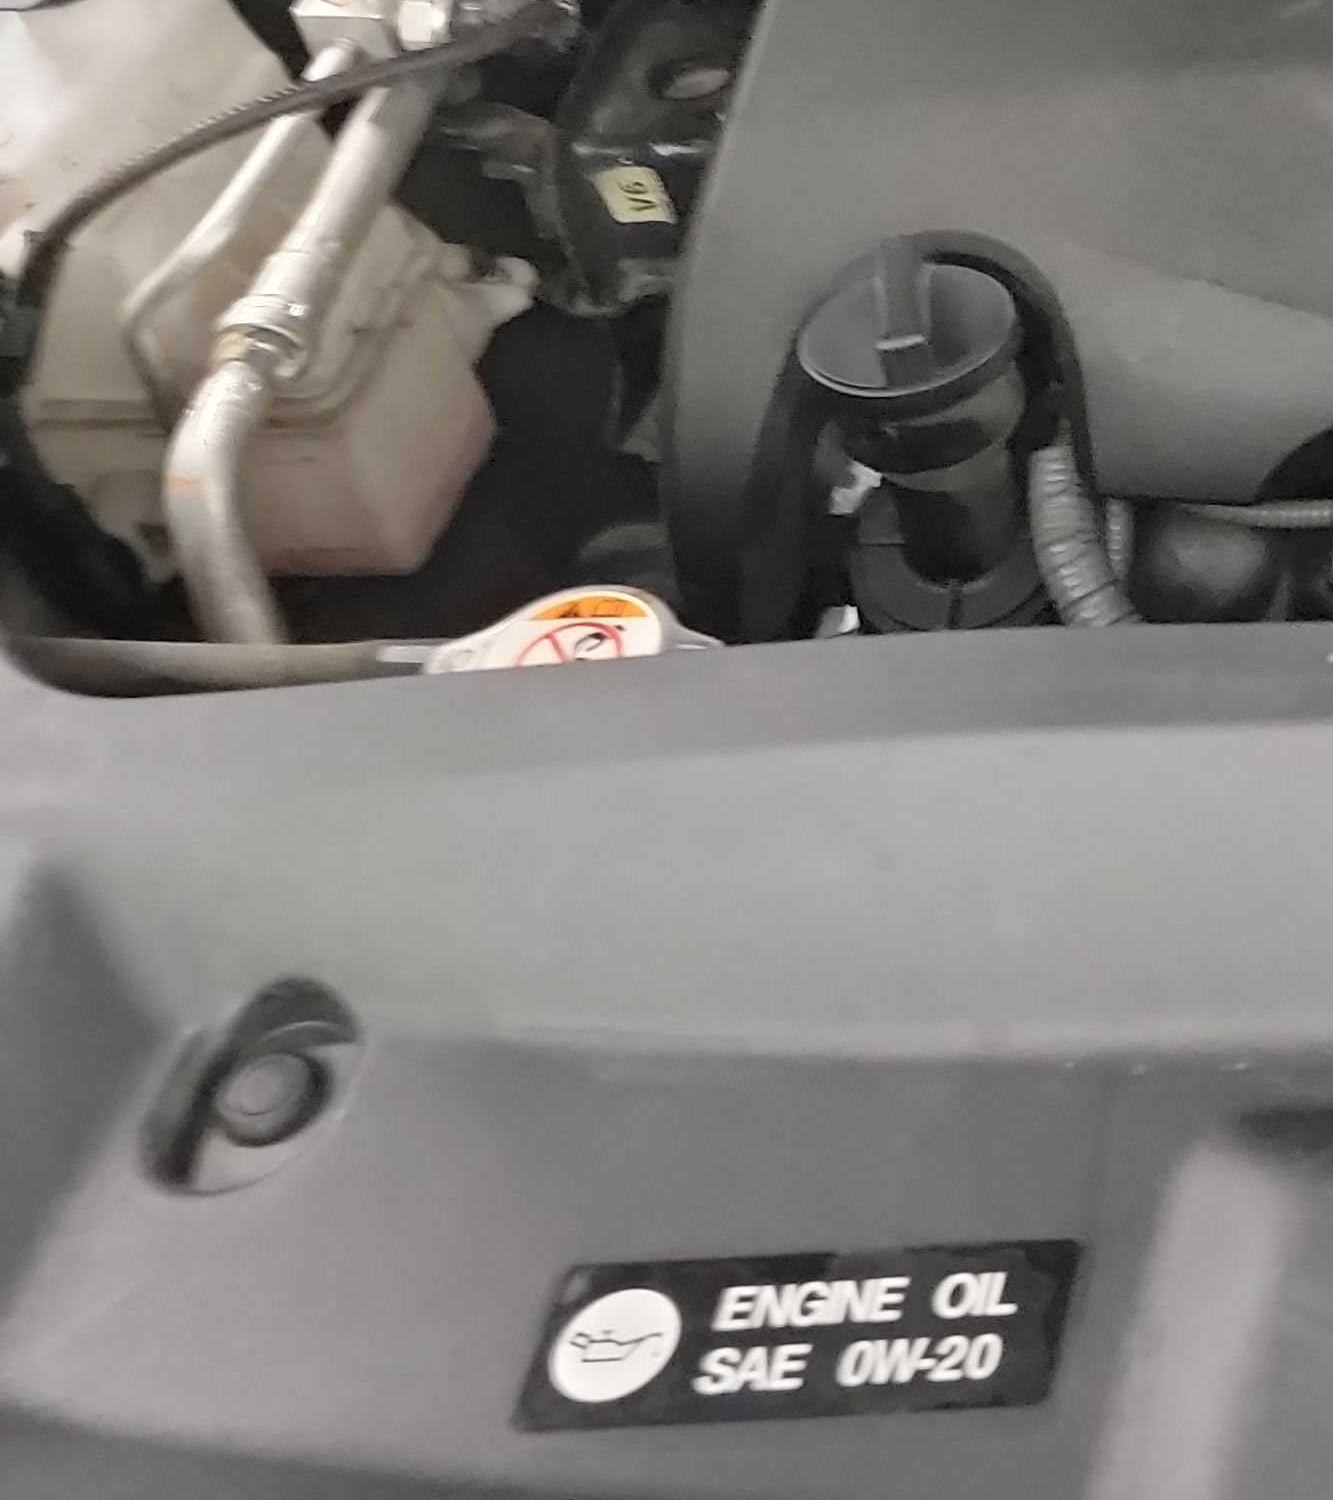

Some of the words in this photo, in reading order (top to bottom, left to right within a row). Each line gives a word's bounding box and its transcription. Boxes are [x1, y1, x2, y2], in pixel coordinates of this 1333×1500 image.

[711, 1275, 910, 1332] ENGINE
[931, 1271, 1019, 1319] OIL
[692, 1342, 813, 1396] SAE
[835, 1332, 1003, 1388] 0W-20
